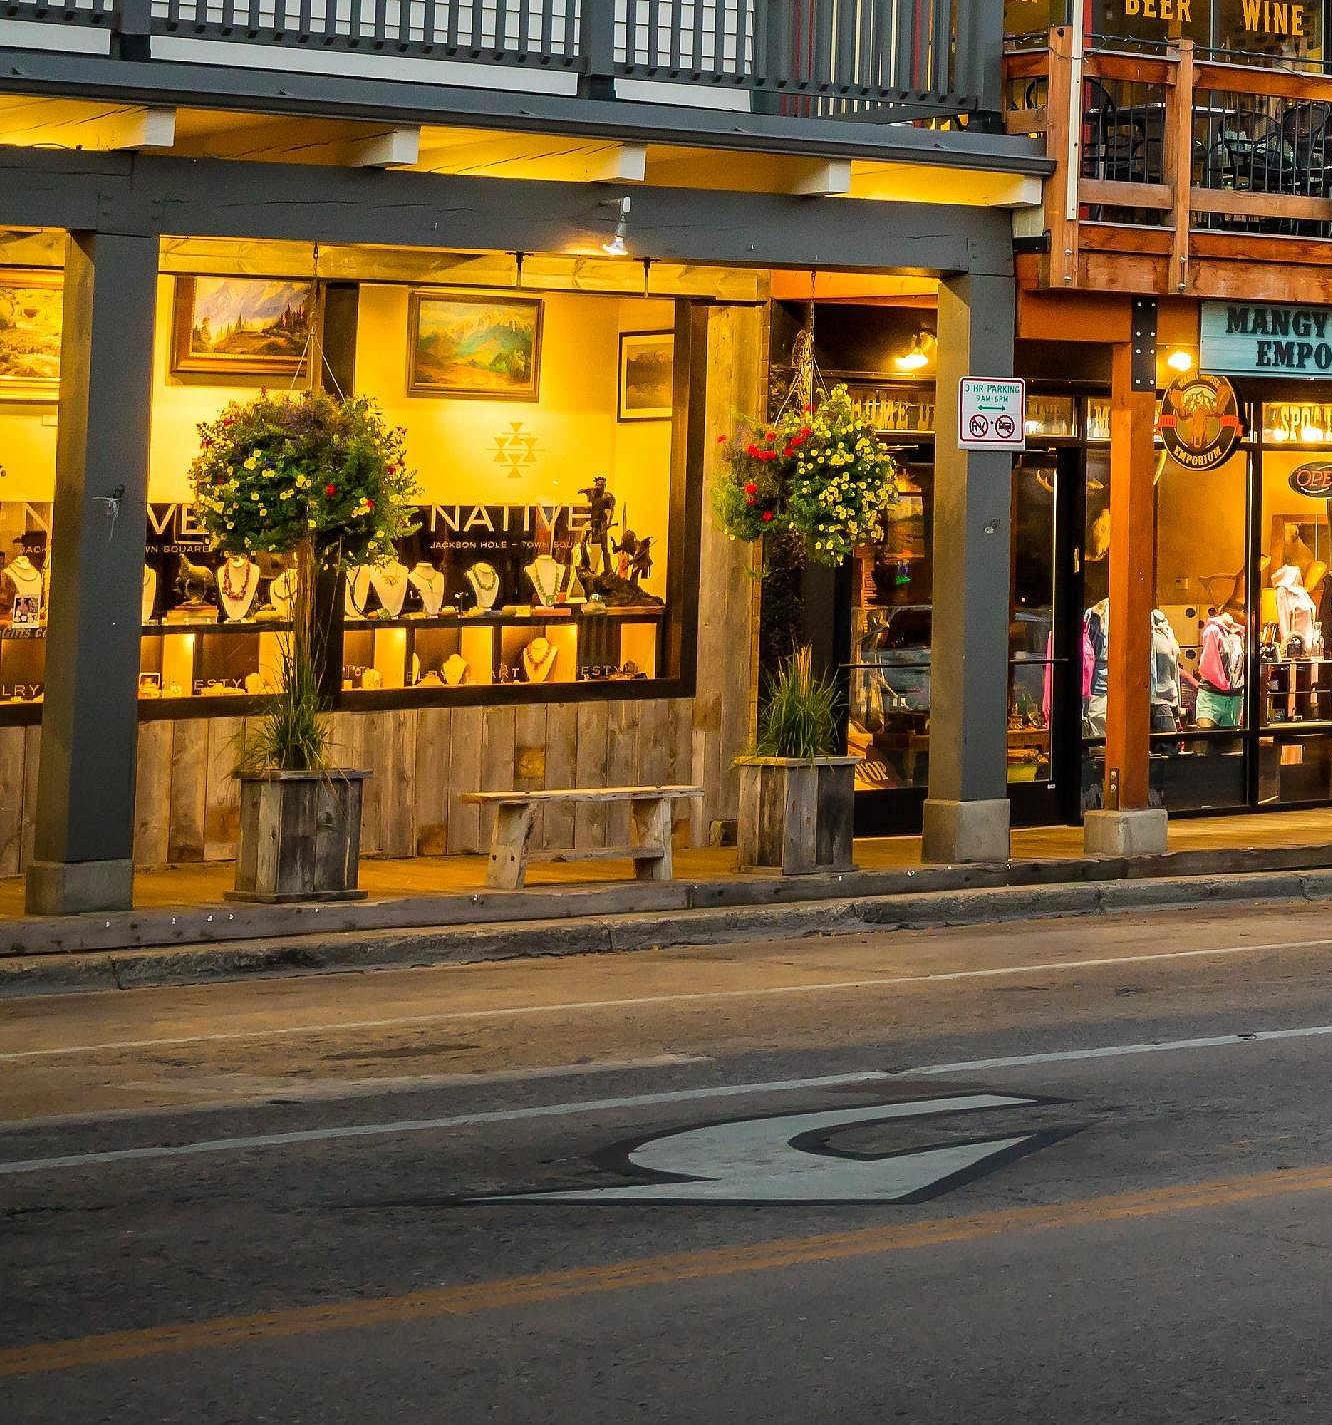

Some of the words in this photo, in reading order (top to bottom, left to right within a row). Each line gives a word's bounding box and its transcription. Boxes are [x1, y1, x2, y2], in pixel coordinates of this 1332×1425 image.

[1226, 305, 1329, 339] MANGY
[973, 385, 984, 393] HR
[986, 384, 1020, 394] PARKING
[1173, 444, 1223, 466] EMPORIUM
[430, 503, 593, 533] NATIVE
[429, 542, 477, 550] JACKSON
[480, 542, 508, 550] HOLE
